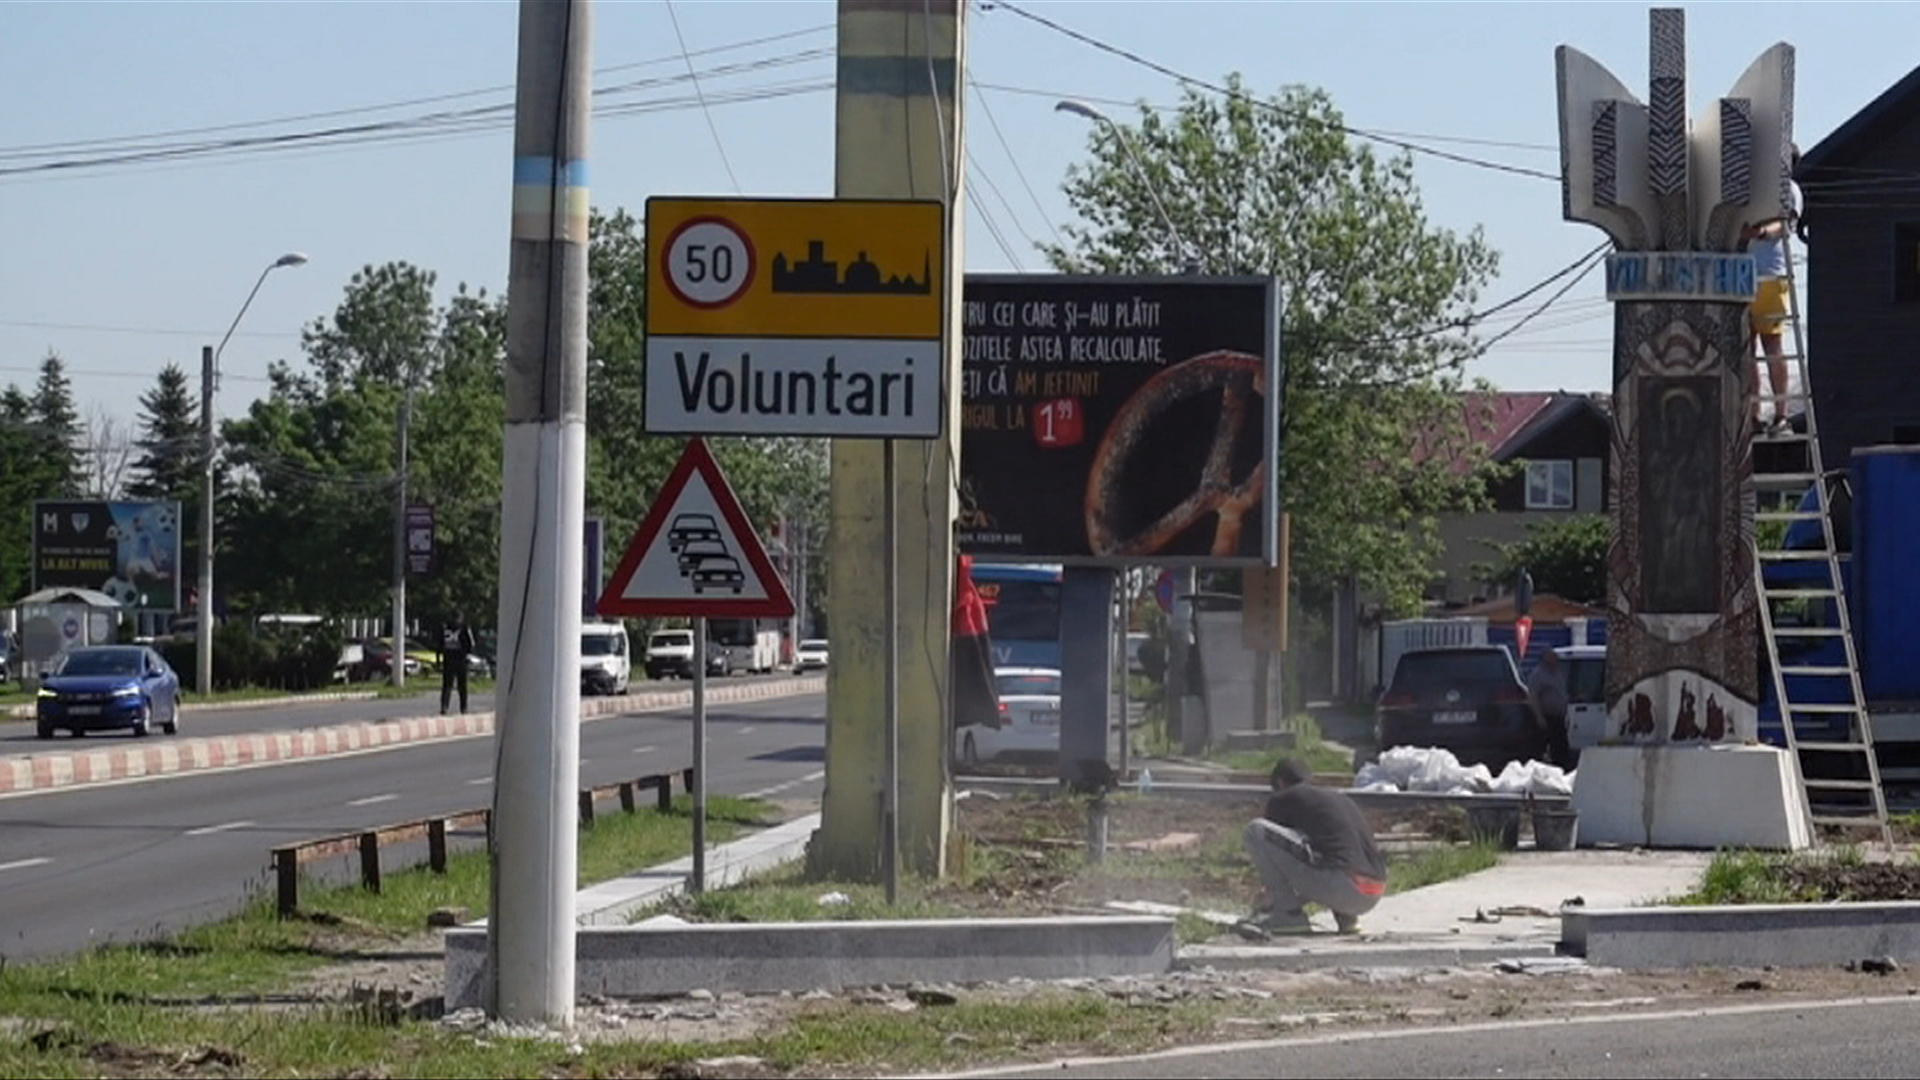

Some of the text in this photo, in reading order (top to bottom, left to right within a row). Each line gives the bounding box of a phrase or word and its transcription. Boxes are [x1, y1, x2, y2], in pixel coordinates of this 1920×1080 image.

[685, 244, 733, 283] 50
[993, 301, 1014, 326] CEI
[1022, 301, 1056, 327] CARE
[1115, 297, 1161, 328] PLĂTIT
[1020, 335, 1063, 362] ASTEA
[1070, 335, 1166, 365] RECALCULATE,
[674, 351, 914, 417] Voluntari
[988, 365, 1007, 395] CĂ
[1015, 368, 1037, 395] AM
[1044, 369, 1099, 396] IEFTINIT
[1006, 403, 1025, 430] LA
